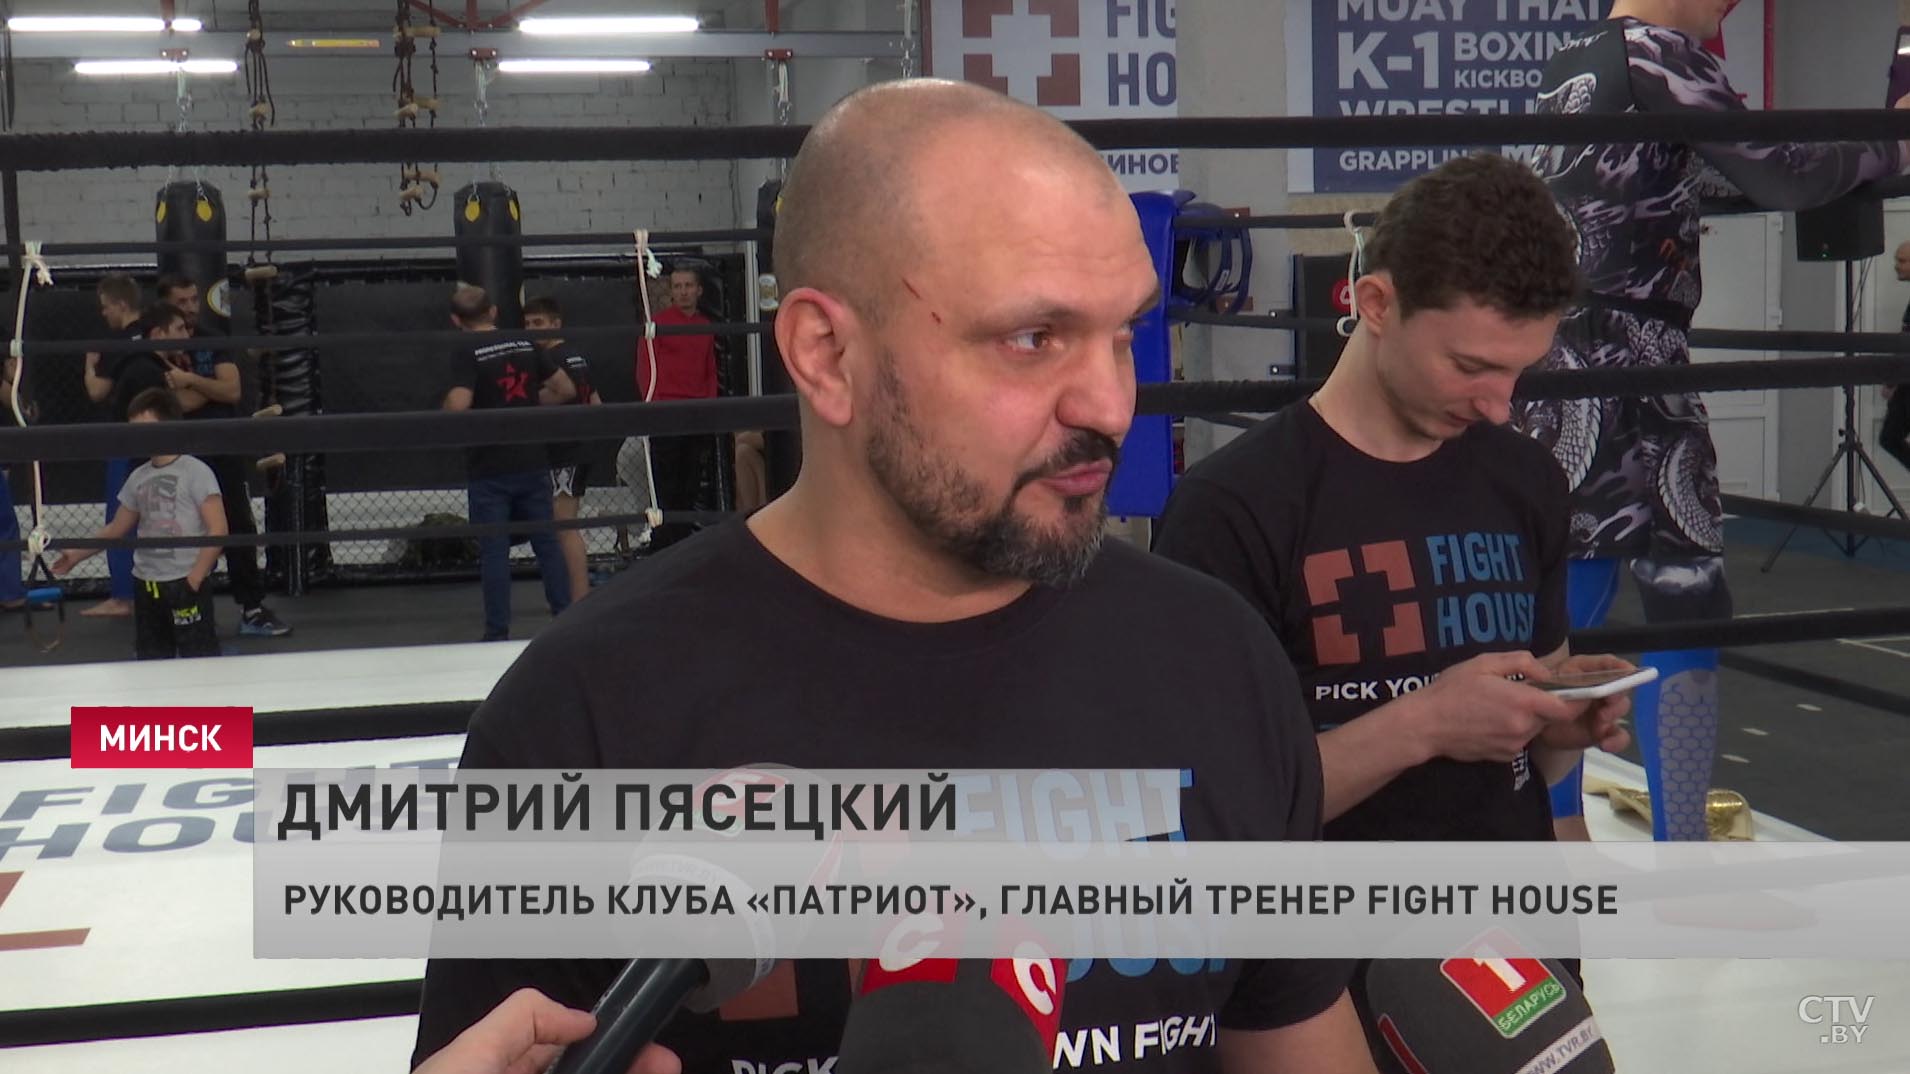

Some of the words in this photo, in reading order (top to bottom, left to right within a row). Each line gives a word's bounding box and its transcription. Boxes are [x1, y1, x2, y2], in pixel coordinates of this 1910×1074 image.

[1338, 31, 1439, 89] K-1
[1426, 532, 1523, 584] FIGHT
[1315, 681, 1378, 700] PICK
[1499, 982, 1561, 1030] БЕЛАРУСЬ
